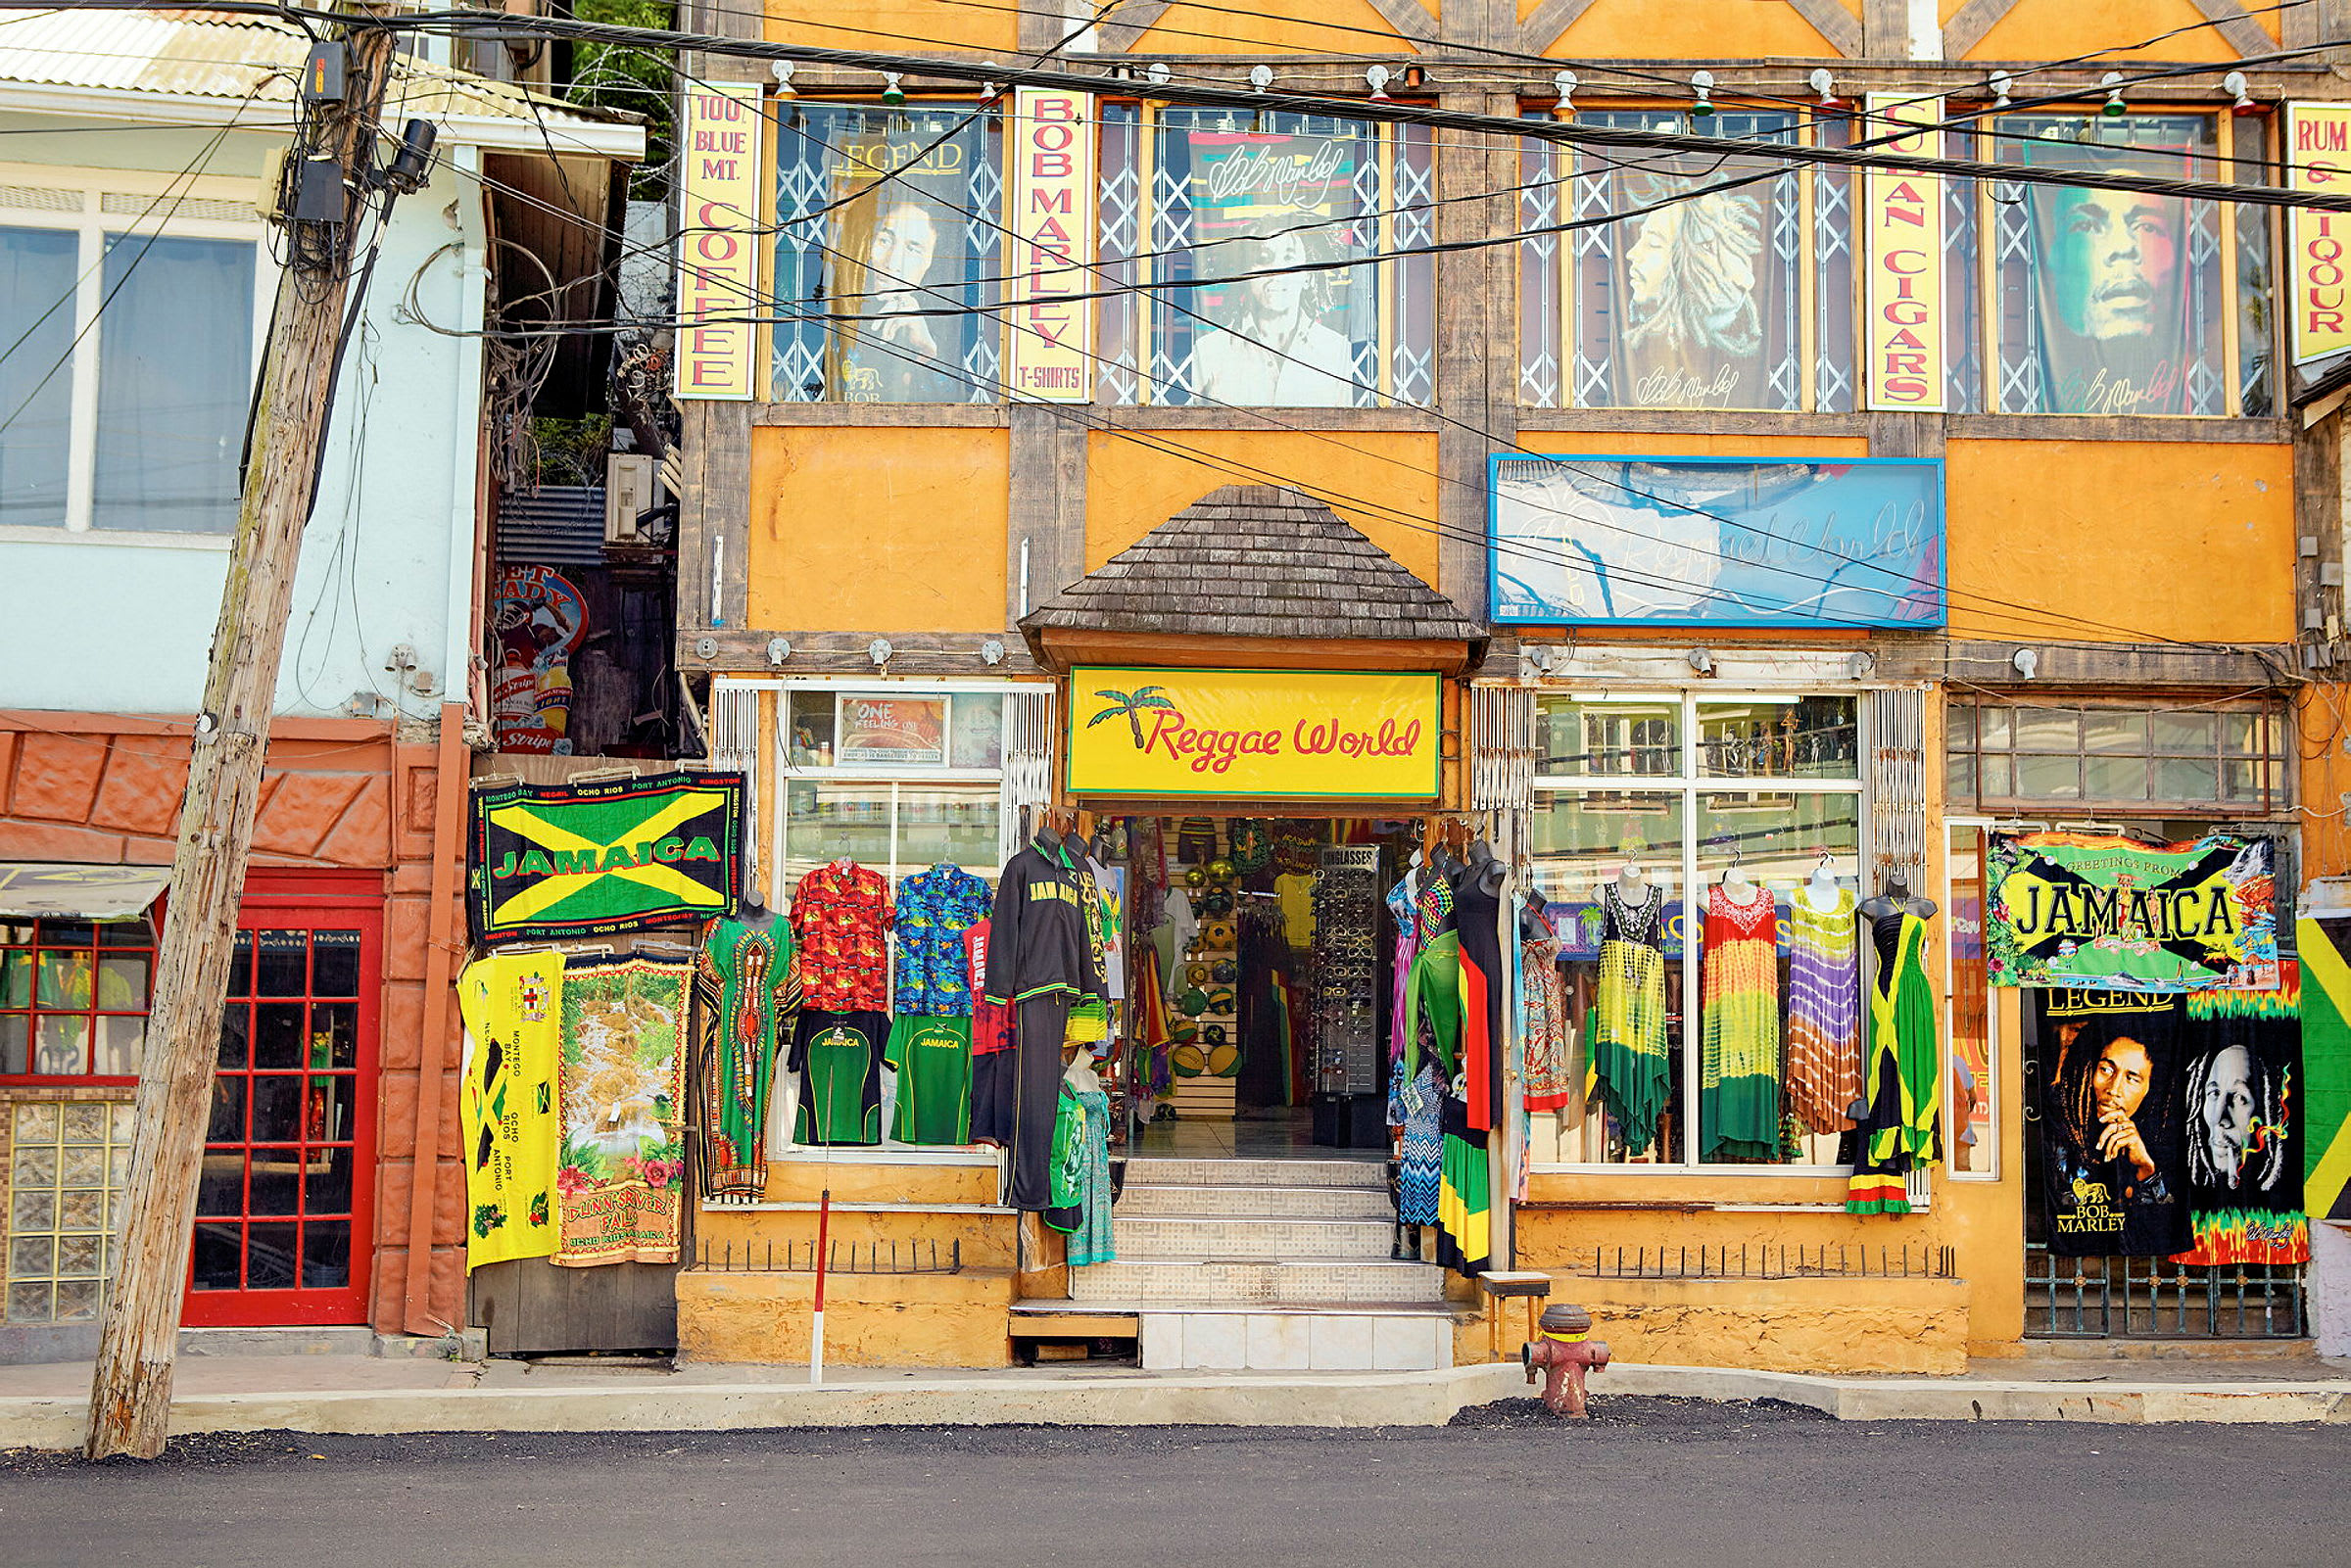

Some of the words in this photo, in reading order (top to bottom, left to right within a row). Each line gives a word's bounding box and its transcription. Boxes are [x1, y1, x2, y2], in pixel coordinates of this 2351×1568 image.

[695, 130, 746, 154] BLUE
[1032, 99, 1074, 177] BOB
[2297, 119, 2348, 151] RUM
[701, 159, 741, 180] MT.
[1030, 188, 1073, 349] MARLEY
[2307, 202, 2344, 334] IQOUR
[692, 202, 740, 387] COFFEE
[1884, 250, 1929, 403] CIGARS
[1020, 366, 1080, 389] T-SHIRTS
[495, 565, 555, 585] ET
[495, 578, 572, 606] ADY
[858, 702, 895, 719] ONE
[1145, 709, 1282, 774] Reggae
[1293, 717, 1421, 759] World
[577, 787, 600, 796] OCHO
[603, 785, 624, 795] RIOS
[632, 782, 653, 790] PORT
[656, 776, 692, 787] ANTONIO
[493, 835, 722, 879] JAMAICA
[2065, 856, 2139, 873] GREETINGS
[2015, 882, 2235, 942] JAMAICA
[550, 927, 587, 936] ANTONIO
[593, 924, 616, 933] OCHO
[619, 920, 640, 930] RIOS
[2046, 987, 2175, 1010] LEGEND
[504, 1043, 512, 1063] BAY
[512, 1030, 521, 1077] MONTEGO
[920, 1038, 959, 1049] JAMAICA
[510, 1112, 519, 1143] OCHO
[494, 1149, 504, 1191] ANTONIO
[504, 1156, 512, 1181] PORT
[625, 1187, 667, 1215] RVER
[2076, 1204, 2110, 1218] BOB
[600, 1211, 639, 1234] FAL
[2057, 1216, 2126, 1233] MARLEY
